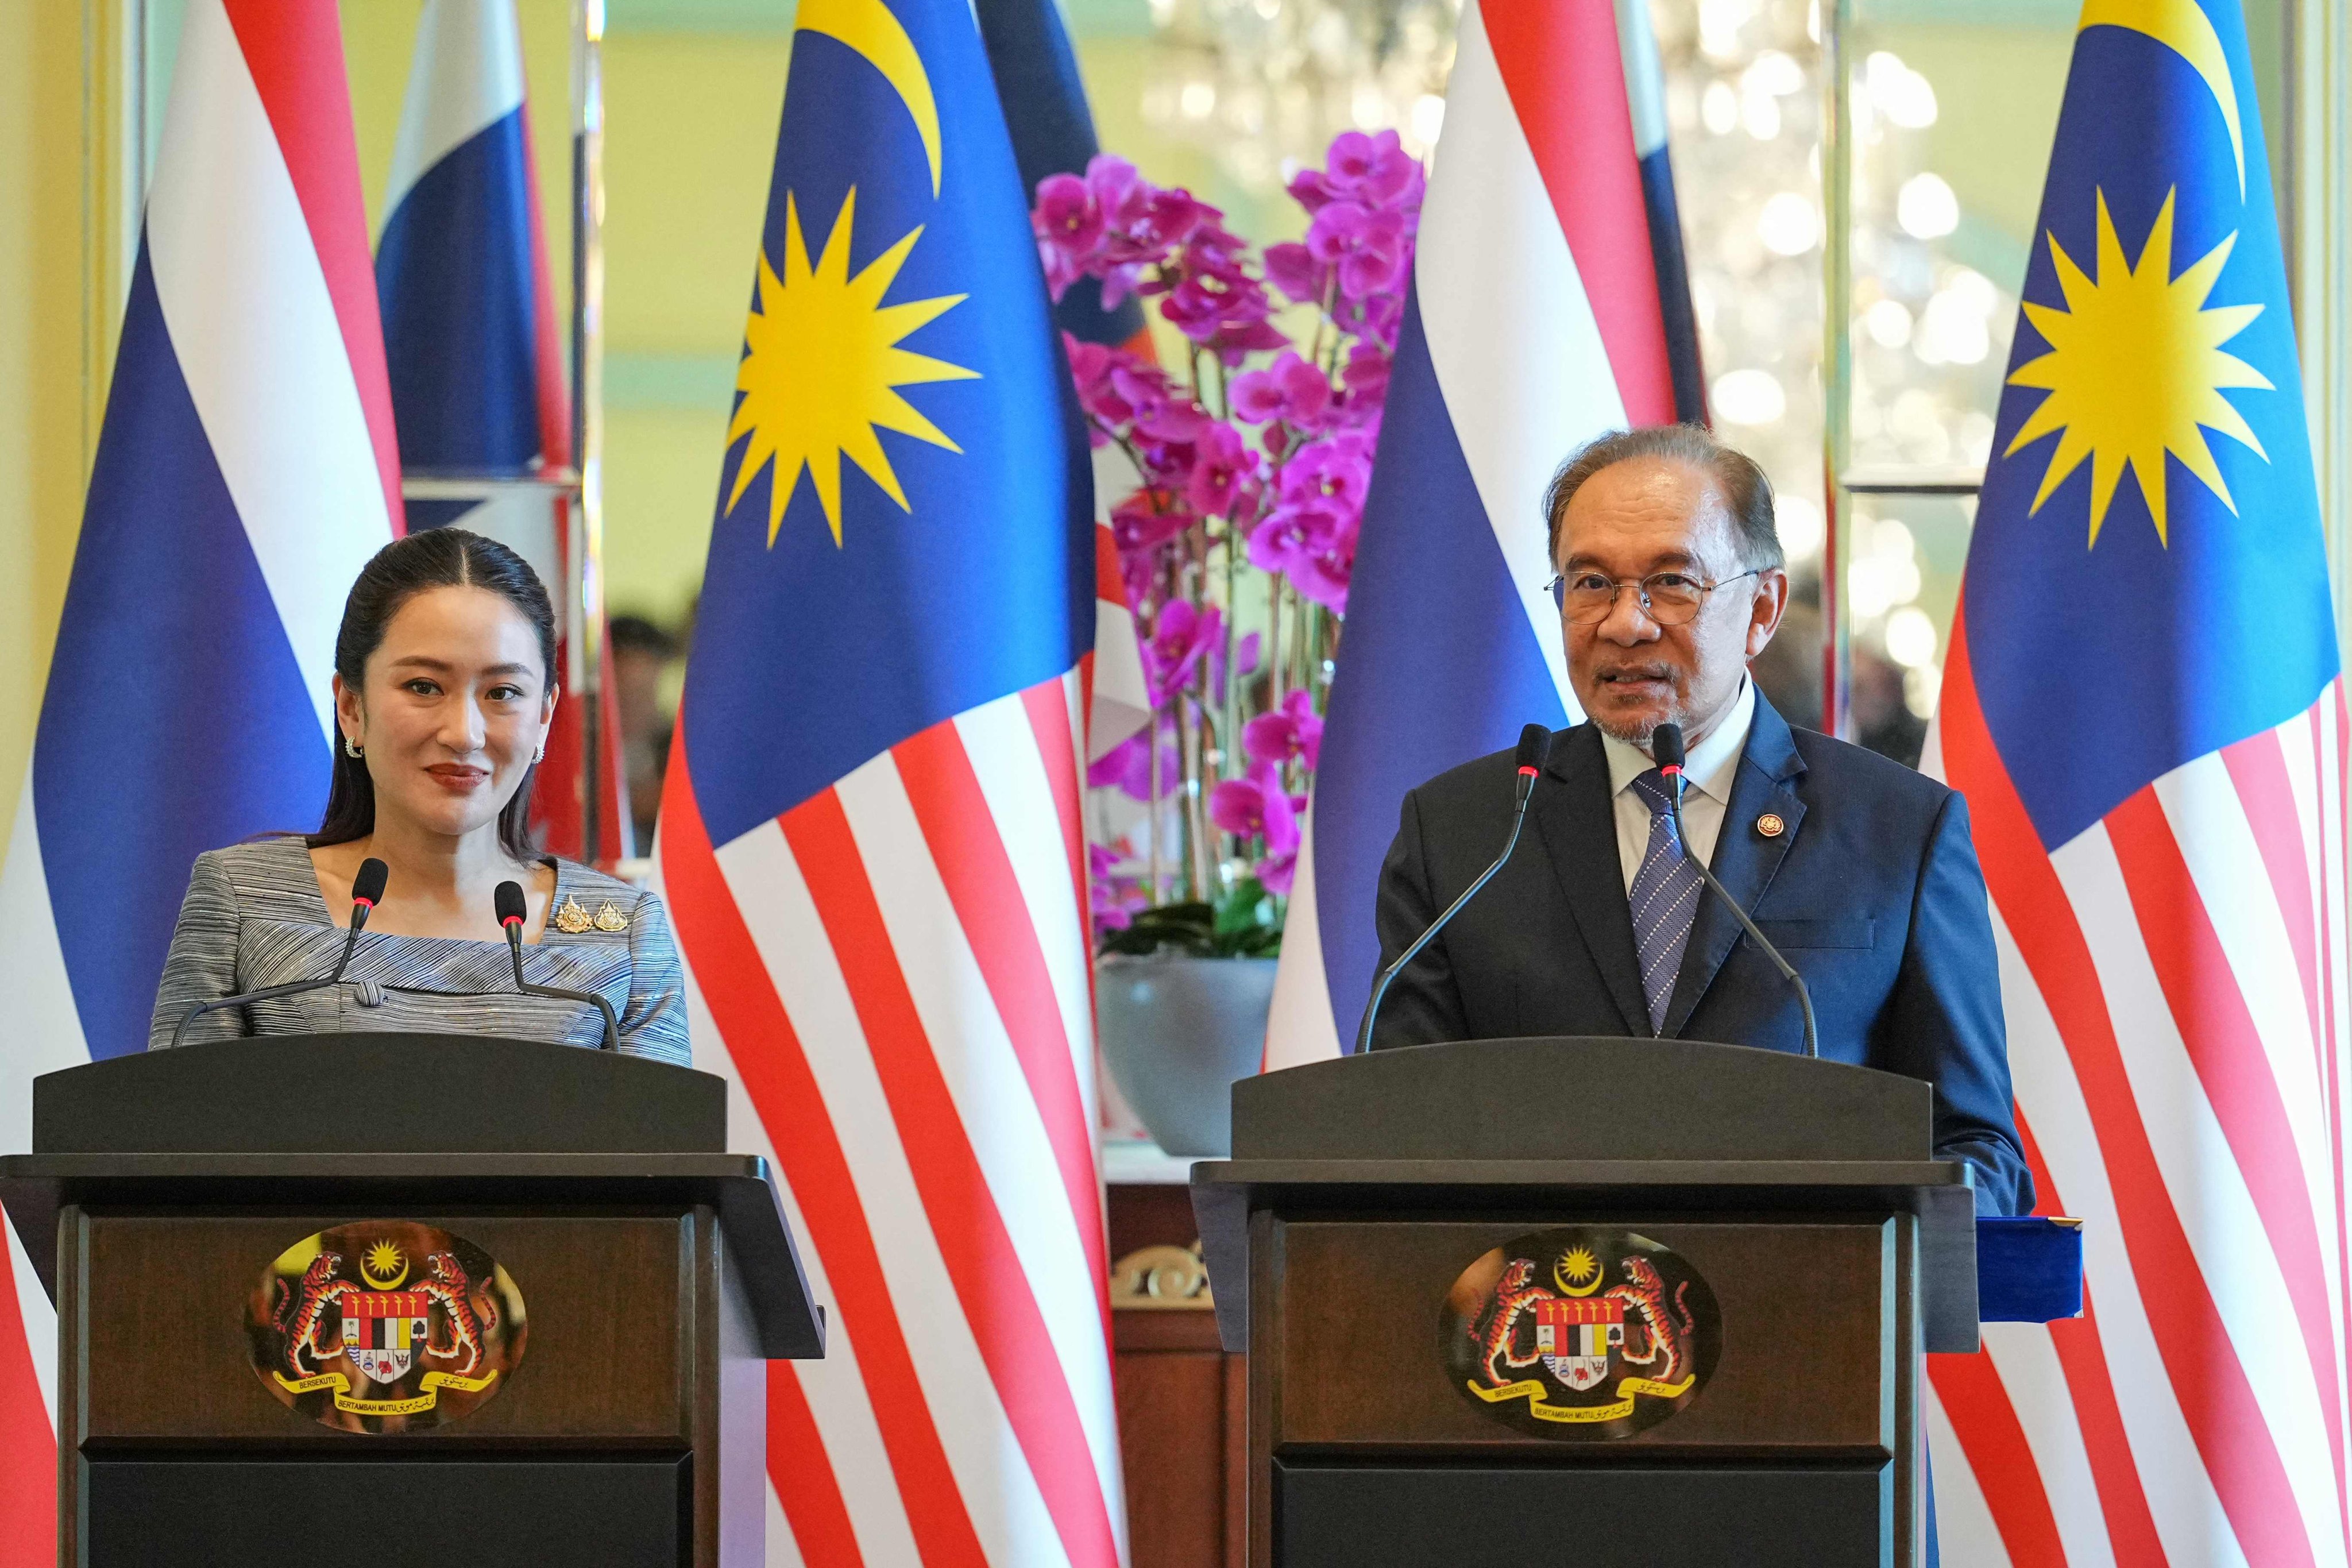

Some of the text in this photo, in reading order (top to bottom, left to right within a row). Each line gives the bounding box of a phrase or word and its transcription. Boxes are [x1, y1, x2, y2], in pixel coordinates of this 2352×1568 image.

[299, 1376, 336, 1389] BERSEKUTU
[338, 1399, 377, 1411] BERTAMBAH
[1534, 1407, 1573, 1418] BERTAMBAH
